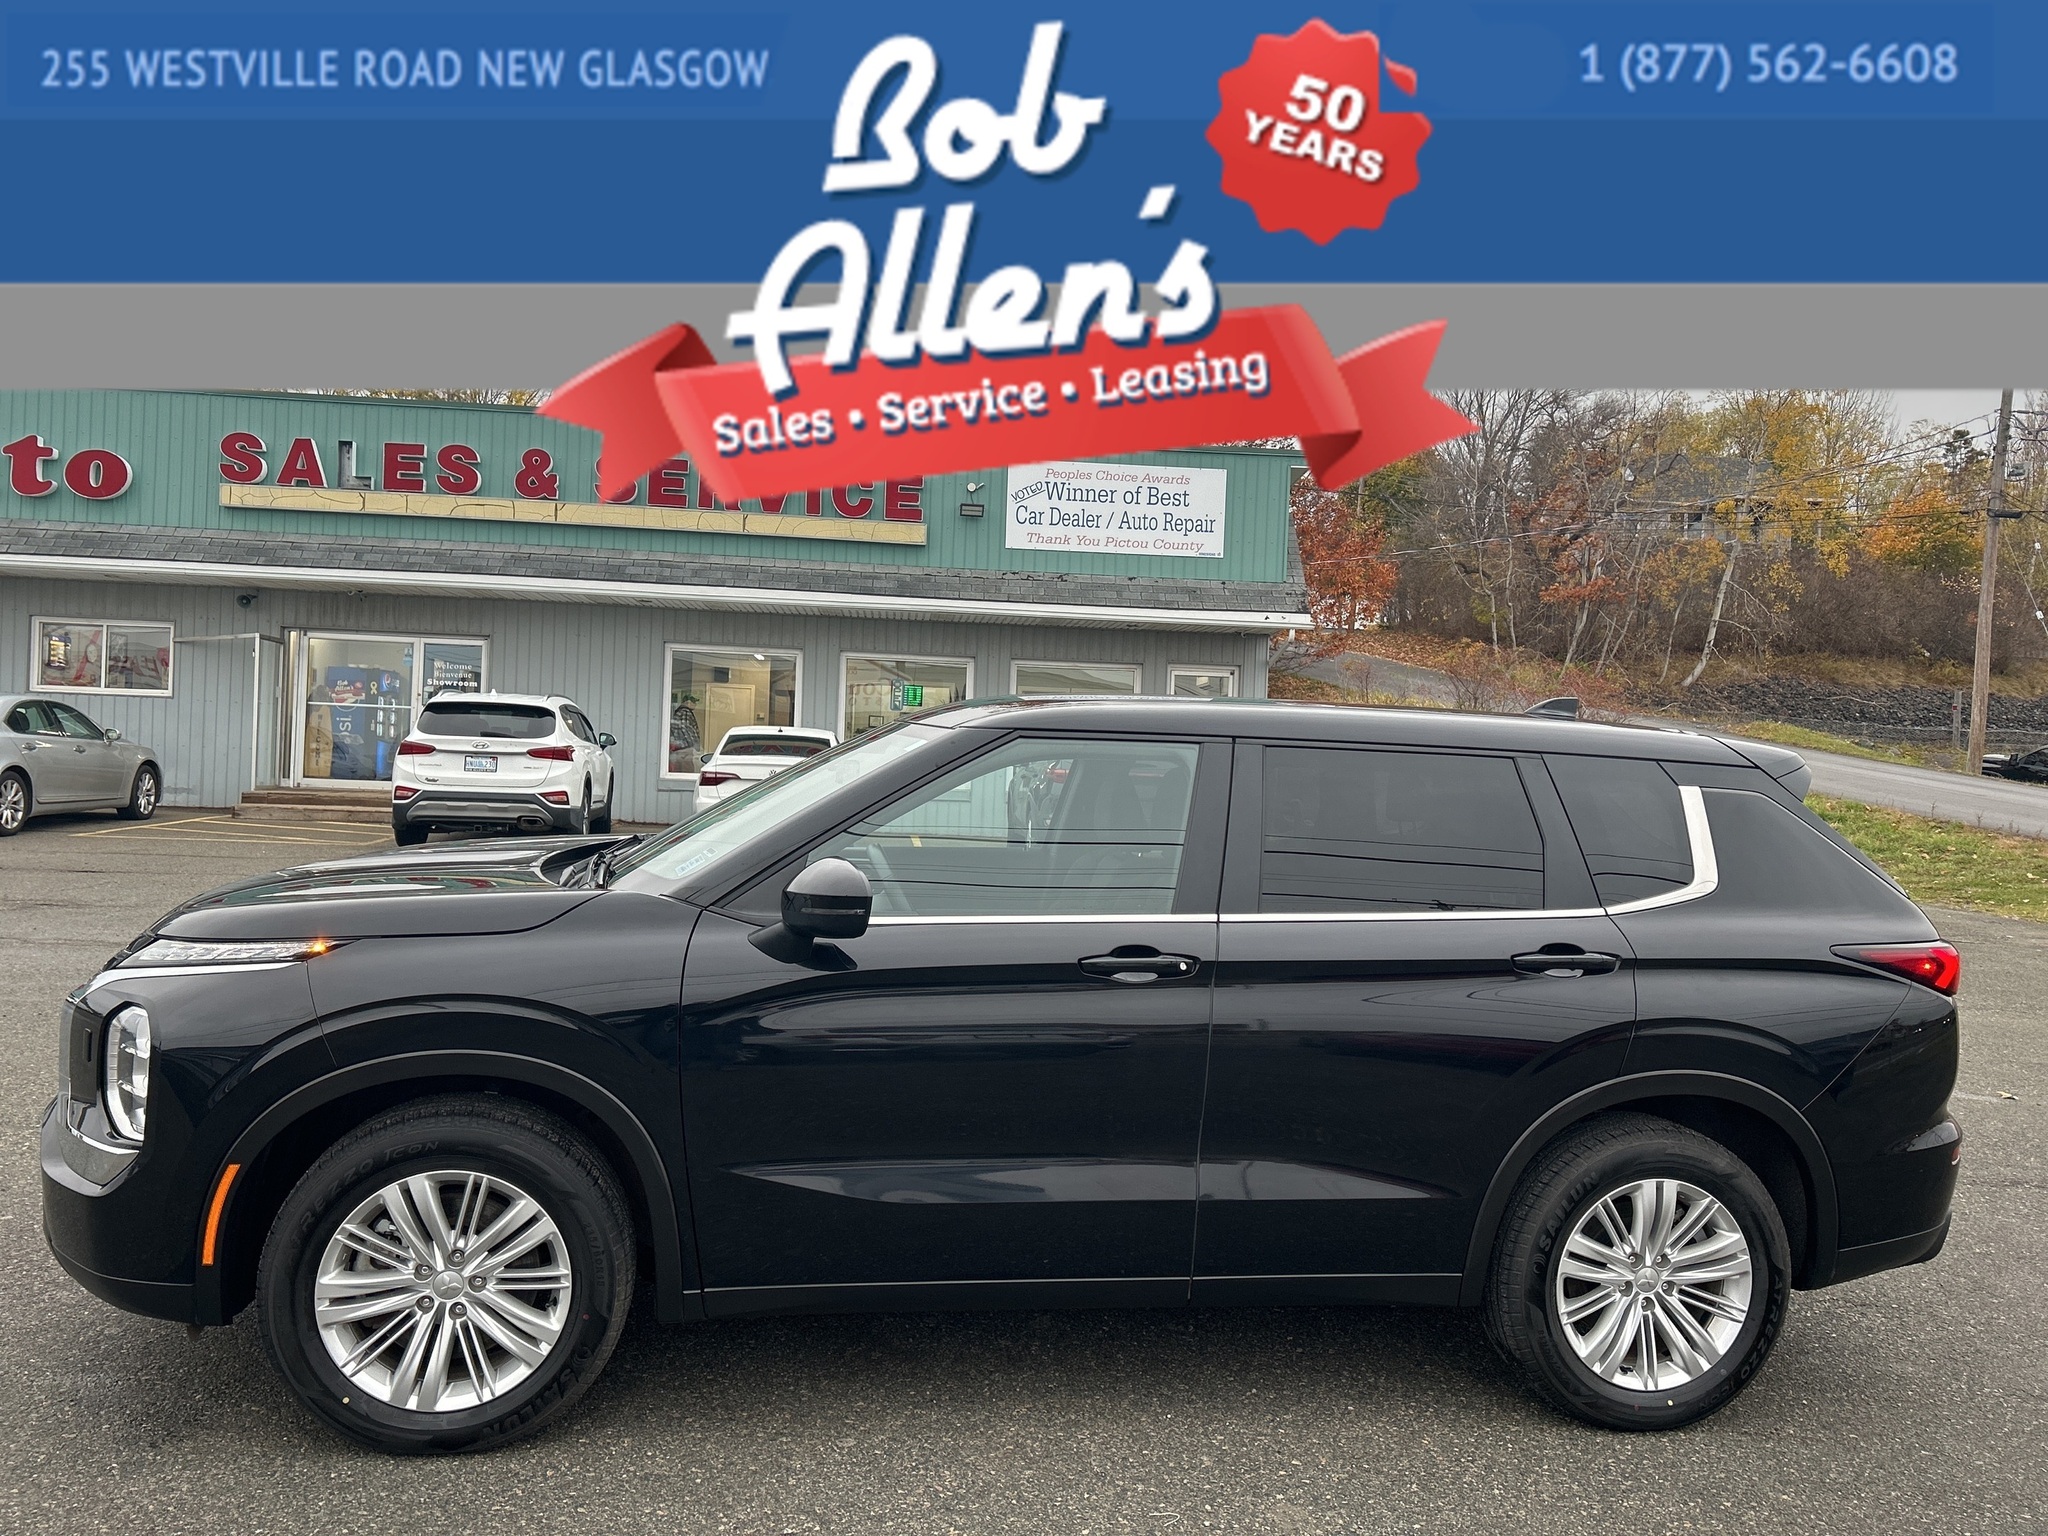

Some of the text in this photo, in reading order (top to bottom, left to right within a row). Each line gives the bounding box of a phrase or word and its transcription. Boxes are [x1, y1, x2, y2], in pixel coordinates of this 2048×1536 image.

[1, 431, 925, 521] to SALES & EICE
[1045, 468, 1190, 485] Peoples Choice Awards
[1011, 481, 1044, 502] VOTED
[1045, 481, 1190, 507] Winner of Best
[1015, 505, 1045, 525] Car
[1049, 507, 1102, 528] Dealer
[1118, 510, 1158, 531] Auto
[1162, 512, 1216, 536] Repair
[1026, 532, 1204, 553] Thank You Pictou County
[434, 662, 473, 670] Welcome
[434, 670, 473, 678] Bienvenue
[427, 678, 478, 687] Showroom
[1539, 1170, 1600, 1252] SAILUN
